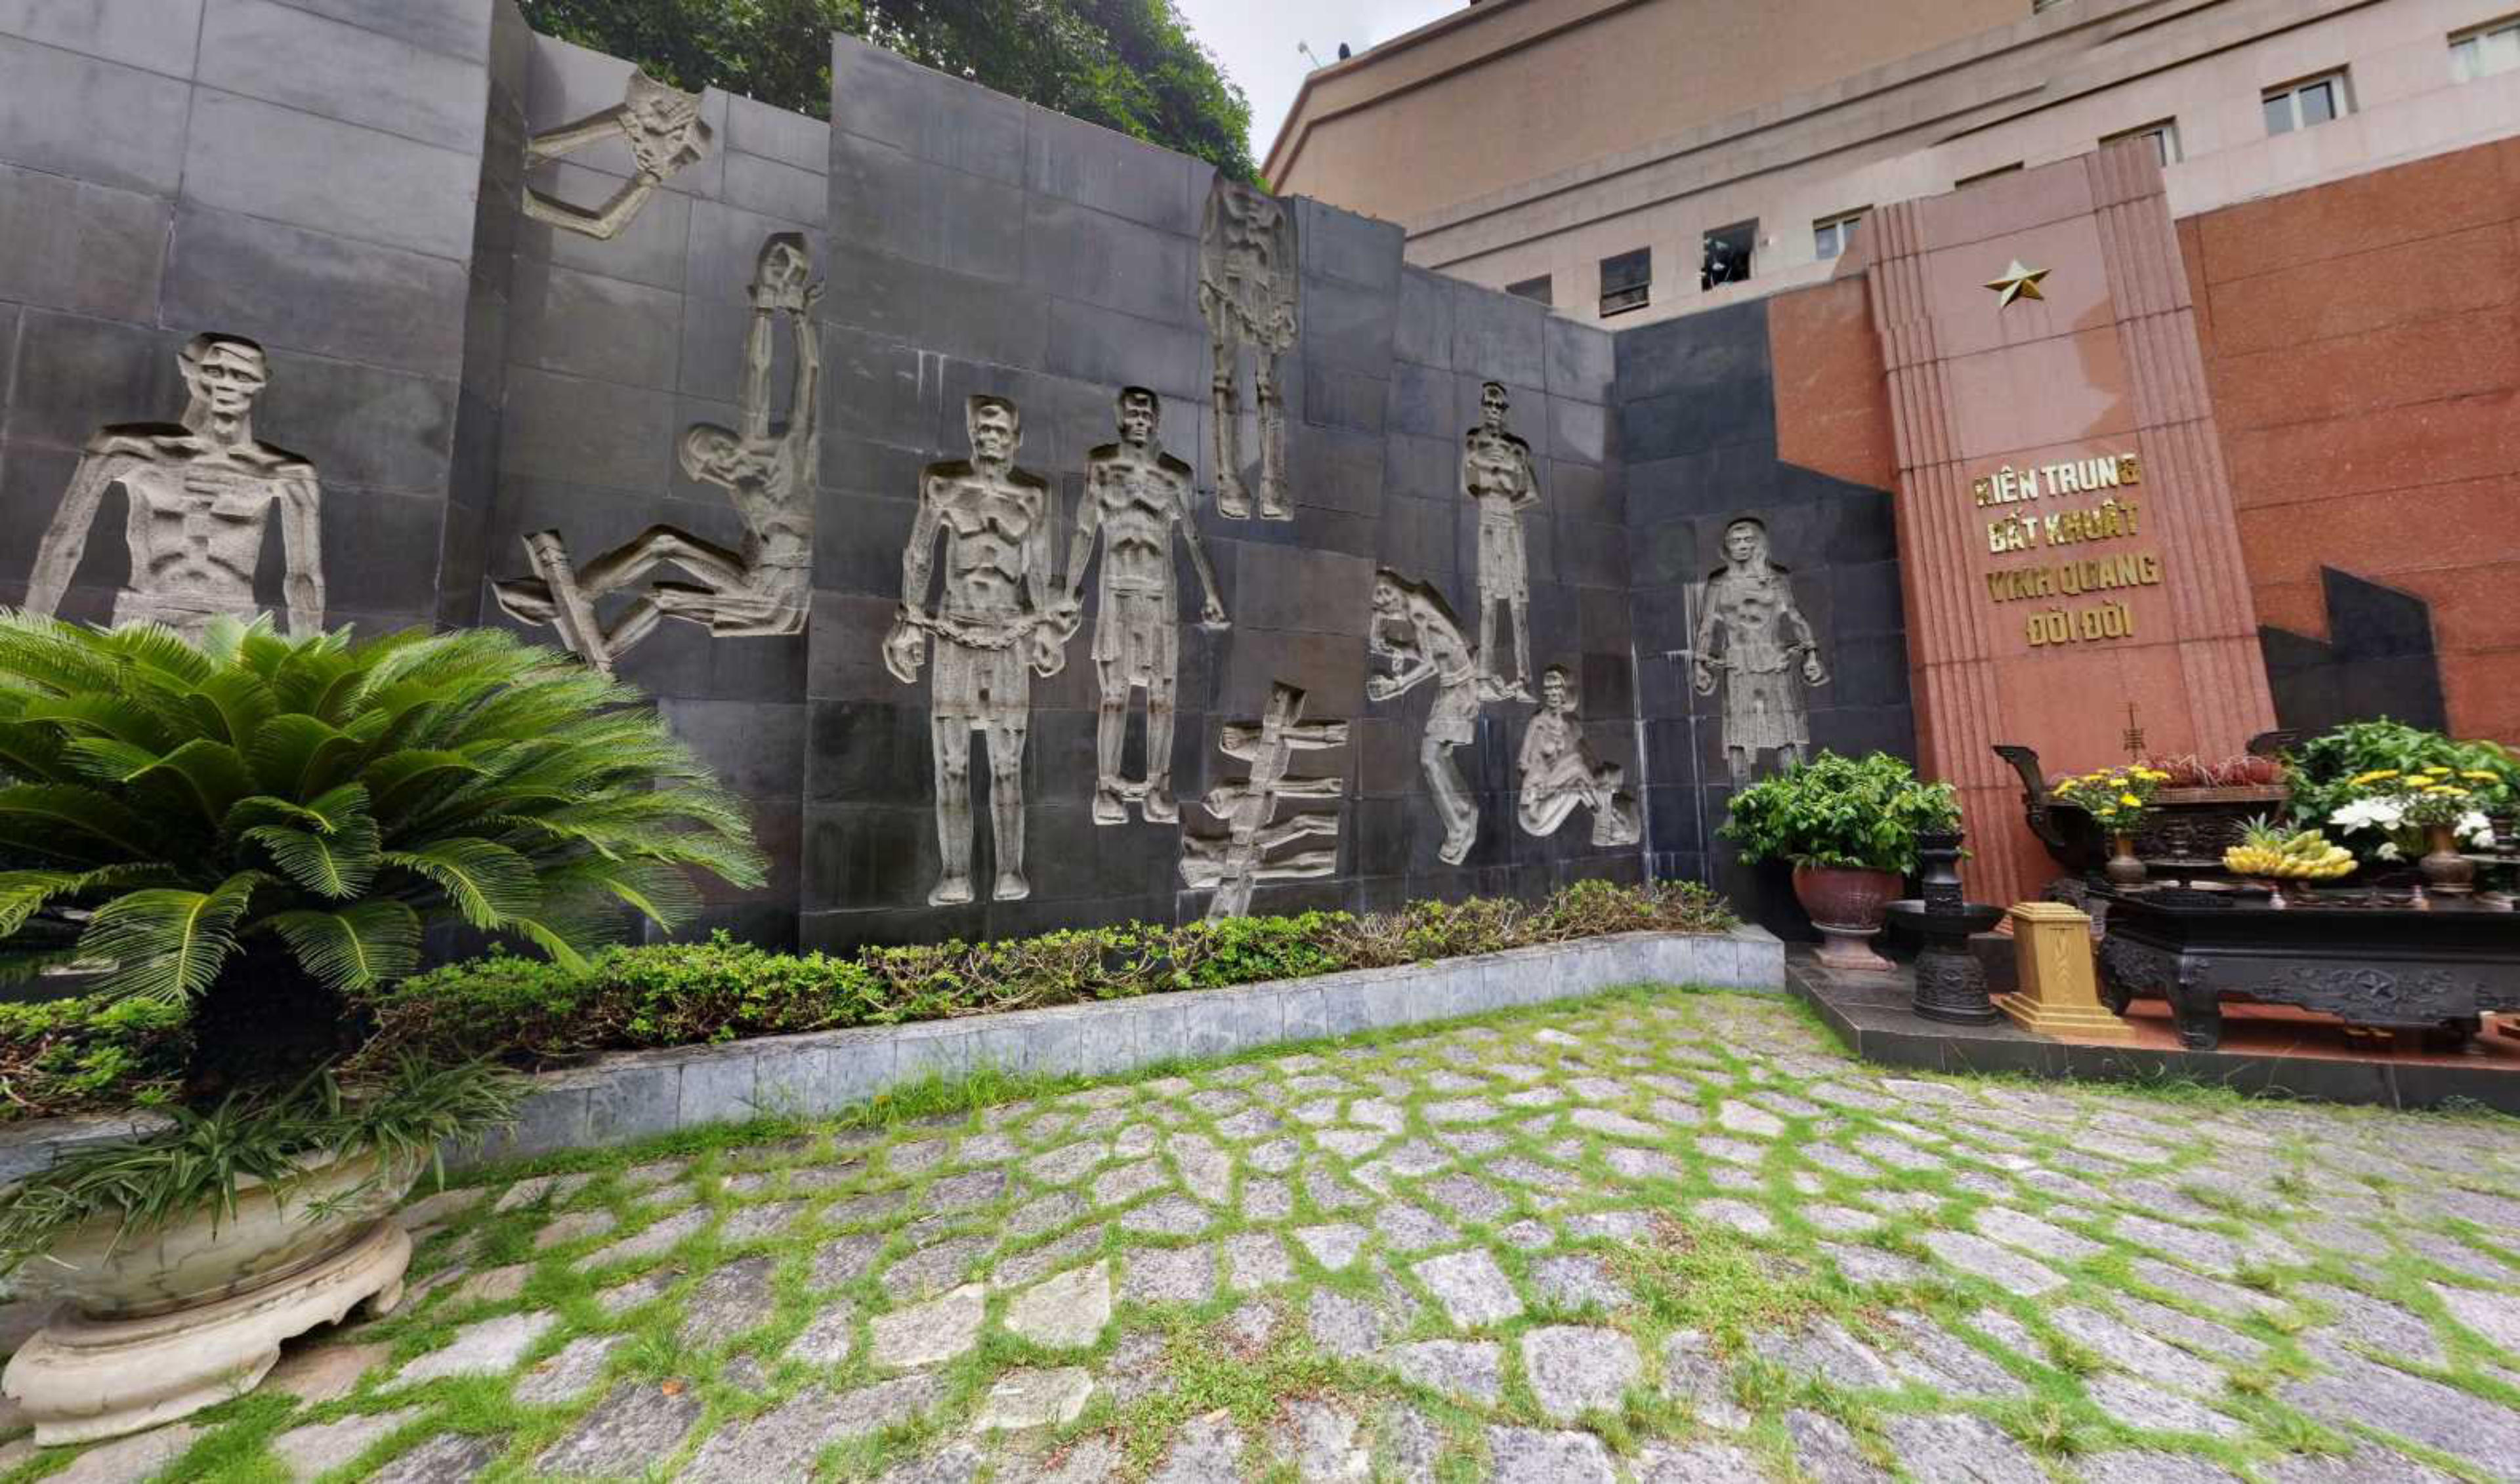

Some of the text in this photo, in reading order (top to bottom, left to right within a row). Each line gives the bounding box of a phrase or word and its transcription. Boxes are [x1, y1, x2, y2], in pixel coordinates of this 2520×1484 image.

[1975, 453, 2140, 507] KIÊN TRUNG
[1988, 506, 2038, 554] BẤT
[1986, 554, 2160, 602] VINH QUANG
